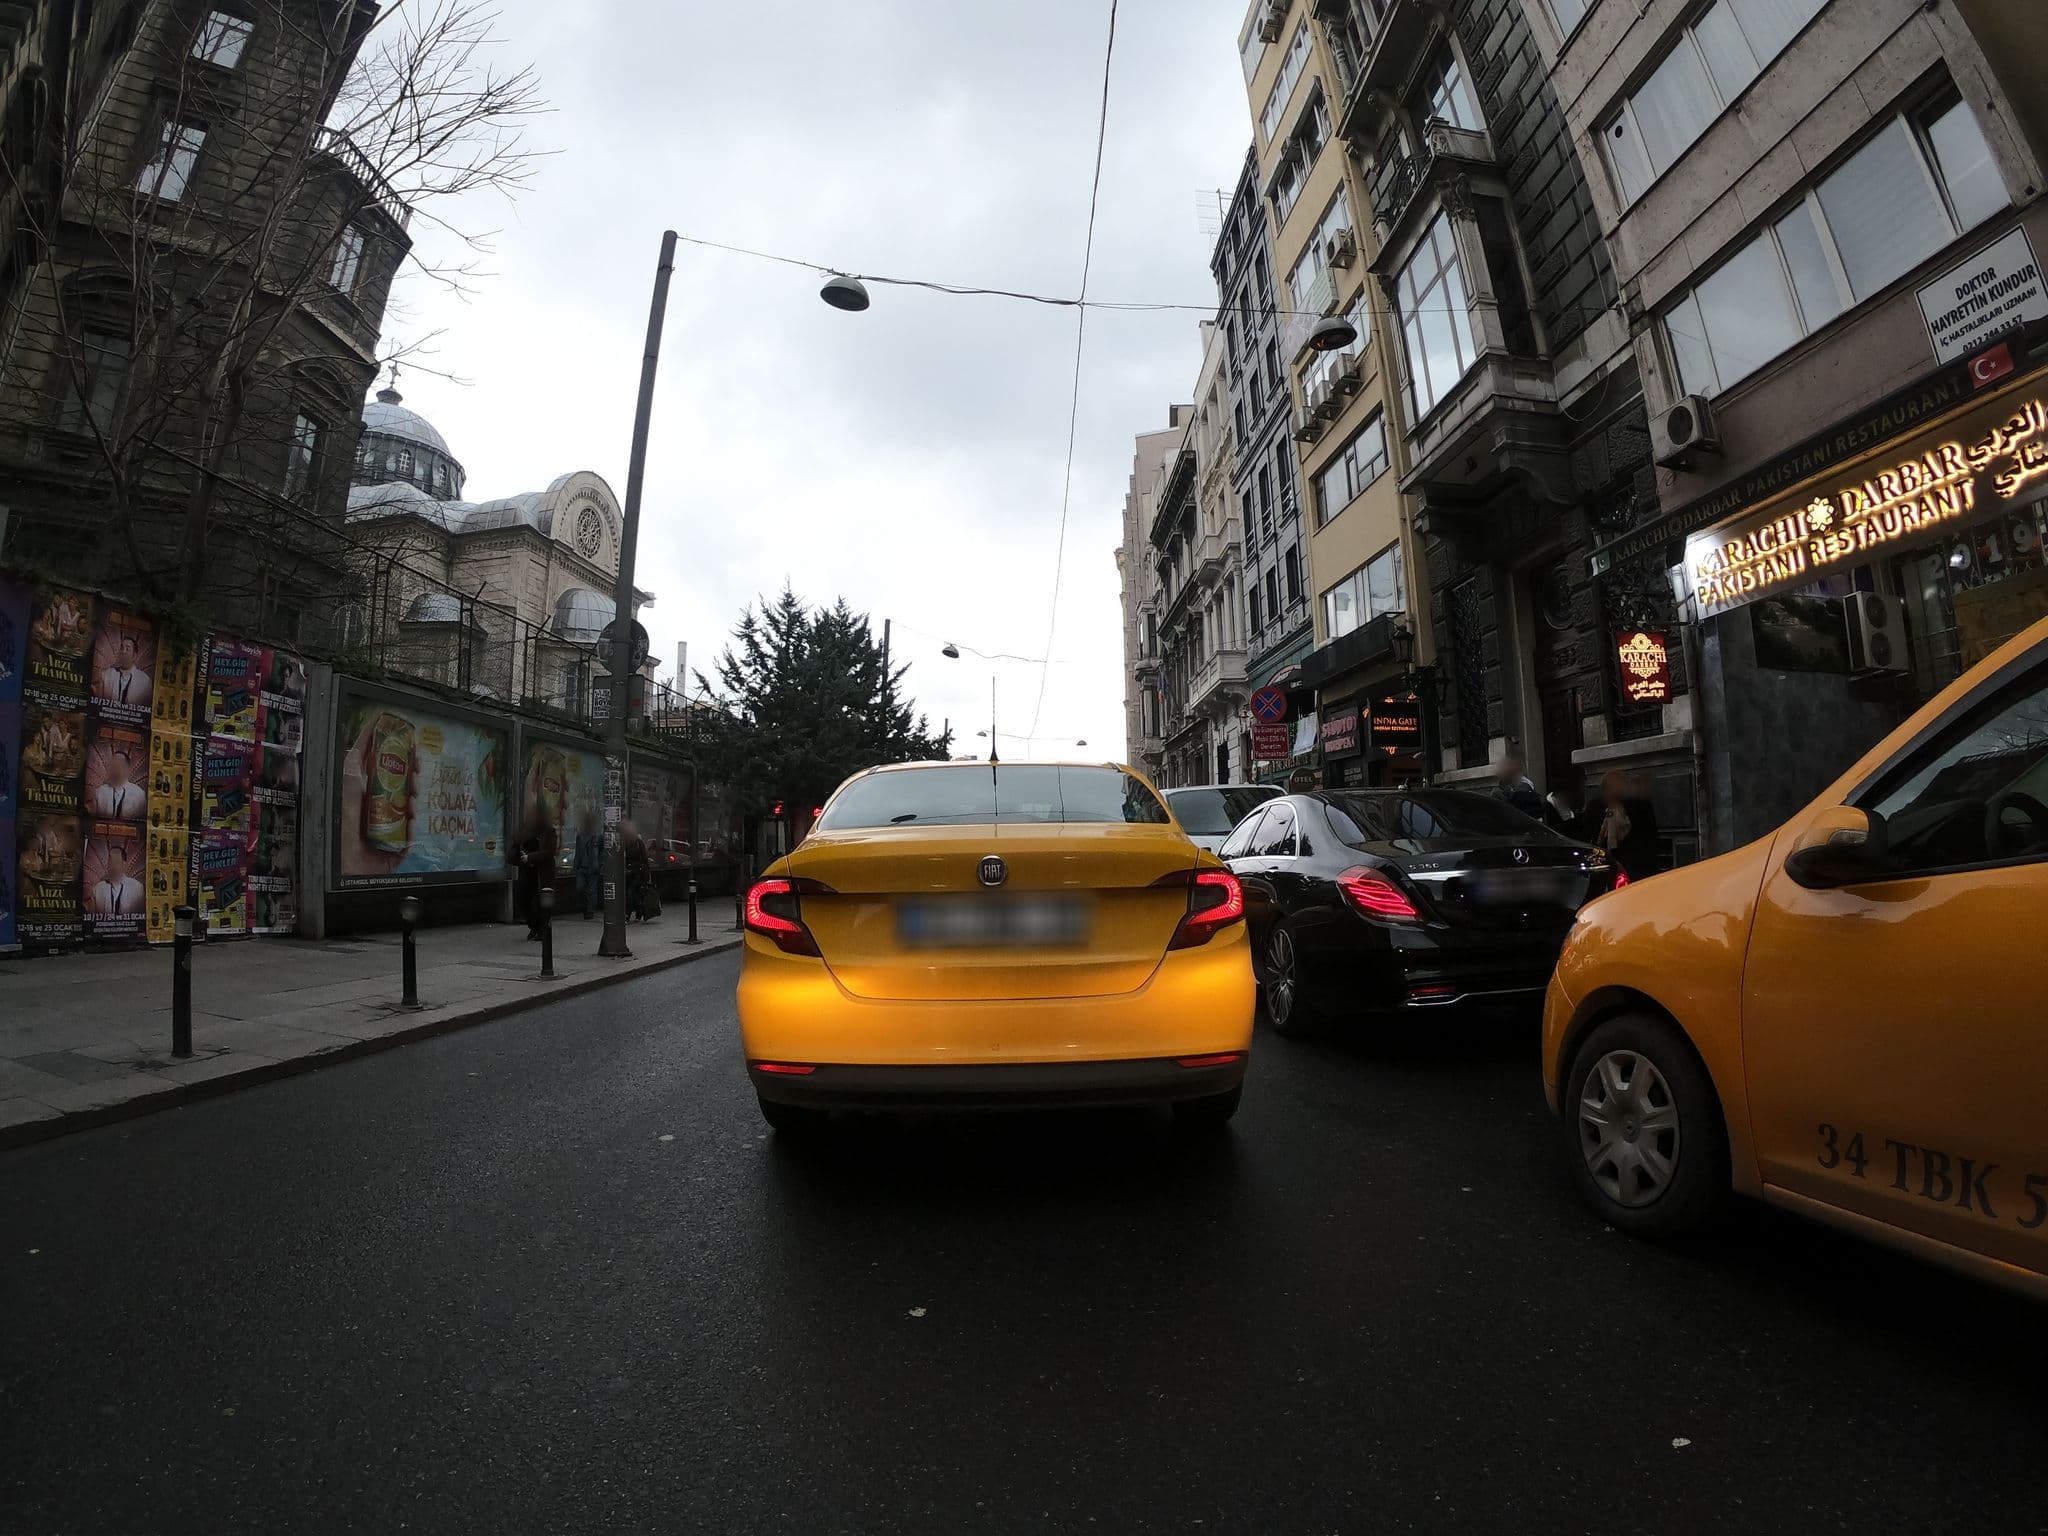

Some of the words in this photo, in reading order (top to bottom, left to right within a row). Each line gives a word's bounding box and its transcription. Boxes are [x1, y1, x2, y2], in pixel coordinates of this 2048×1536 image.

[1930, 293, 1987, 335] HAYRETTİN
[1988, 264, 2037, 301] KUNDUR
[1955, 267, 1997, 300] DOKTOR
[1939, 336, 1949, 350] İÇ
[1949, 306, 2003, 342] HASTALIKLARI
[2003, 286, 2037, 312] UZMANI
[1967, 399, 2046, 471] العربي
[1616, 526, 1669, 561] KARACHI
[1682, 490, 1740, 528] DARBAR
[1746, 444, 1834, 498] PAKISTANI
[1837, 378, 1963, 453] RESTAURANT
[1696, 511, 1809, 578] KARACHI
[1838, 443, 1969, 521] DARBAR
[1698, 545, 1805, 605] PAKISTANI
[1809, 479, 1975, 566] RESTAURANT
[1620, 652, 1667, 662] KARACHI
[1374, 717, 1397, 725] INDIA
[1398, 717, 1417, 725] GATE
[381, 754, 405, 773] Lipton
[984, 864, 1001, 879] FIAT
[1818, 1123, 1869, 1178] 34
[1884, 1137, 2000, 1218] TBK
[2016, 1174, 2048, 1229] 5
